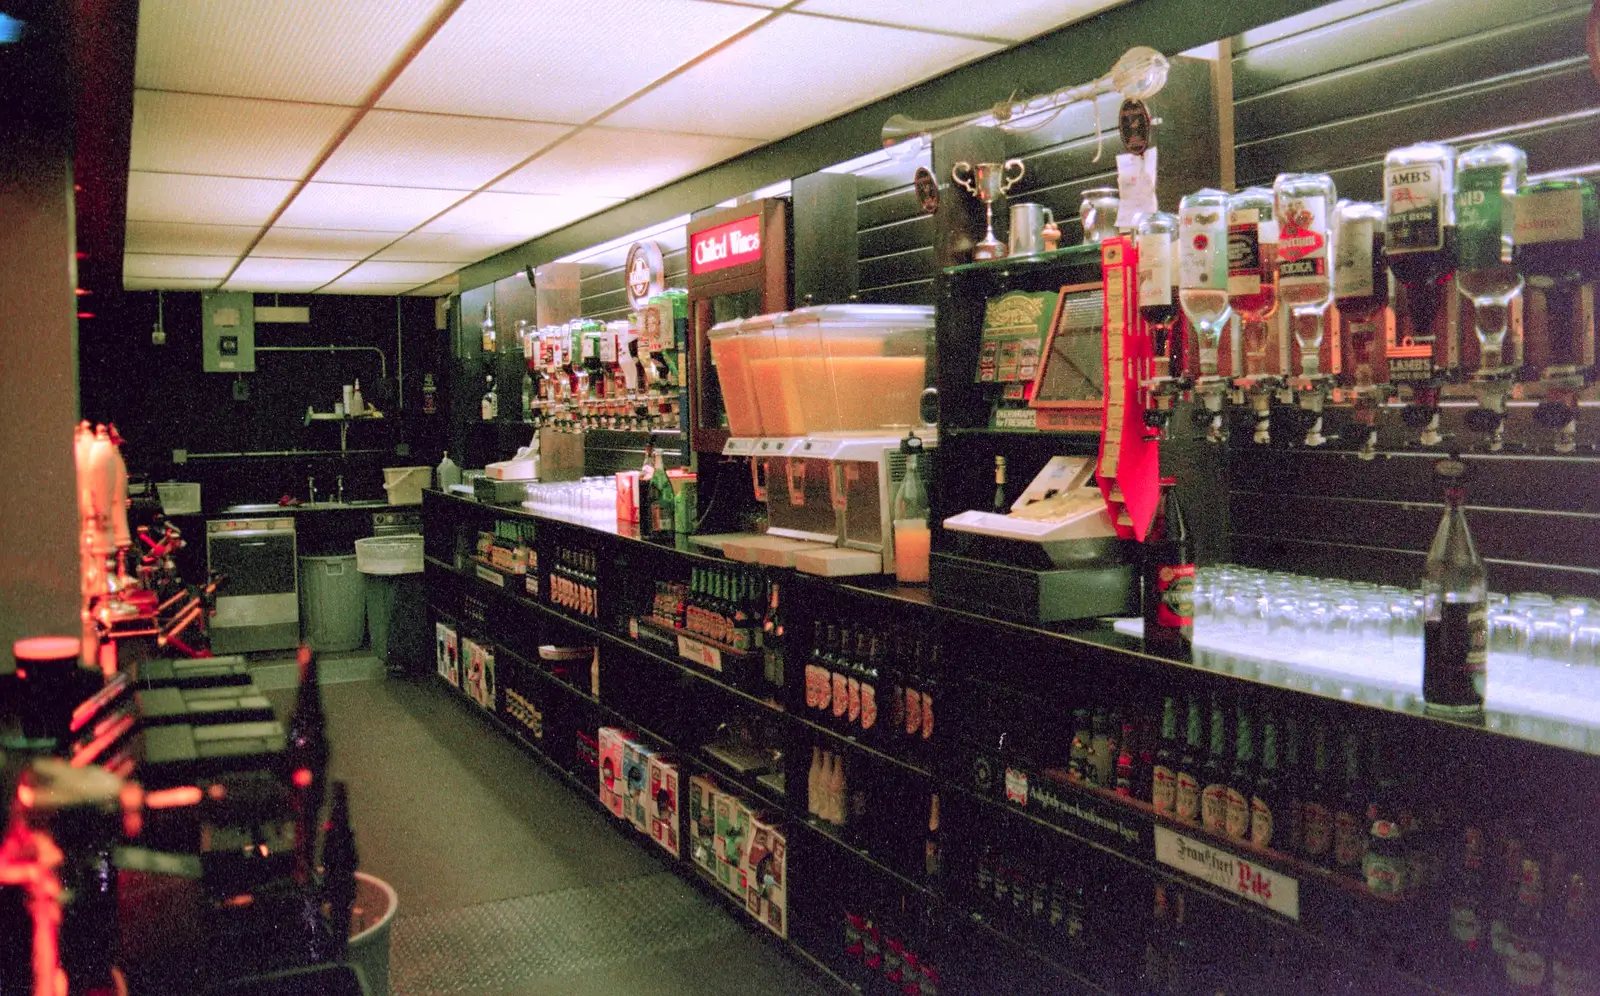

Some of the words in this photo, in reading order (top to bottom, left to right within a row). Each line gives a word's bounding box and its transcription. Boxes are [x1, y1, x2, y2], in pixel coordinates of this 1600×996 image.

[1390, 170, 1431, 186] AMB'S
[695, 232, 727, 265] Chilled
[729, 229, 760, 255] Wines
[1177, 836, 1234, 877] Frankfurt
[1236, 860, 1273, 899] Pils
